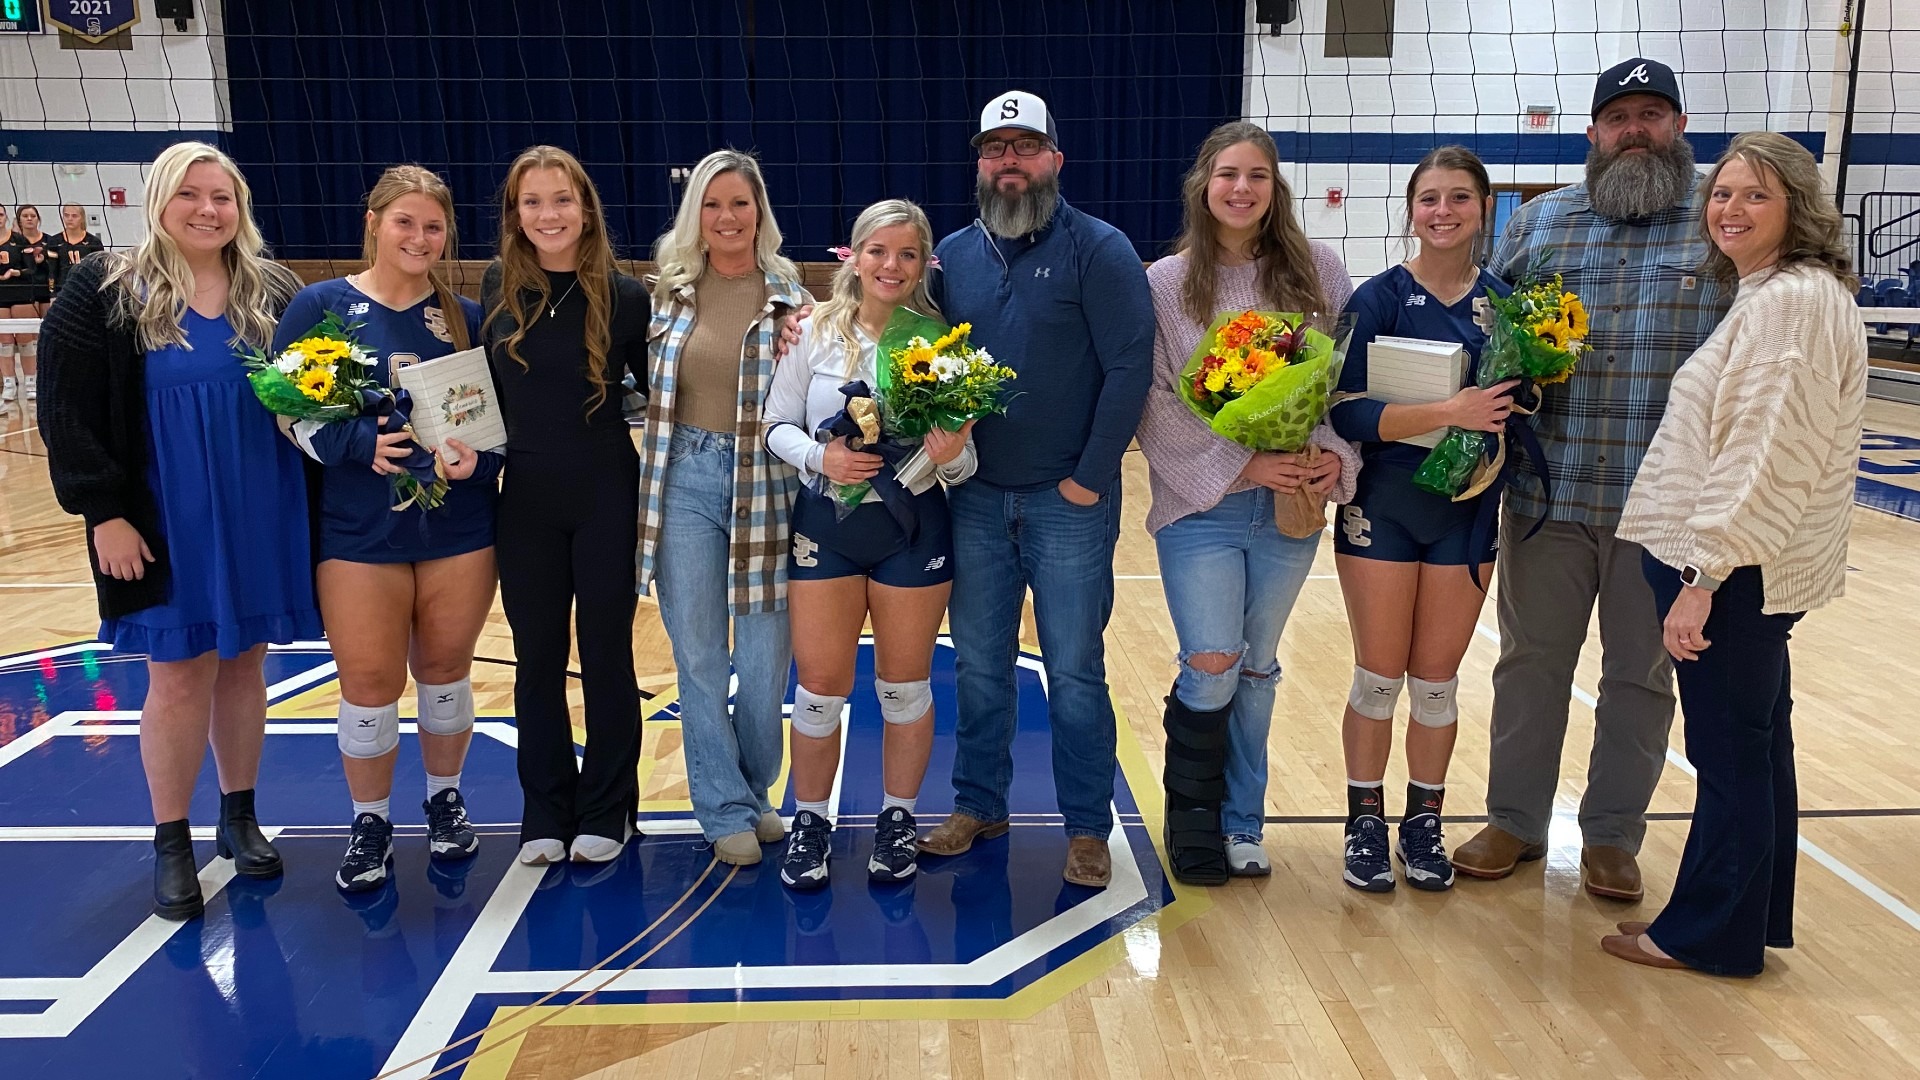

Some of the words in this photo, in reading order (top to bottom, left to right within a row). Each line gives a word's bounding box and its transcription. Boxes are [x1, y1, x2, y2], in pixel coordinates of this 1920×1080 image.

[69, 0, 111, 15] 2021
[1618, 63, 1649, 86] A
[1000, 98, 1019, 121] S
[1530, 112, 1549, 127] EXIT
[1247, 404, 1283, 424] Shades
[1284, 392, 1296, 405] of
